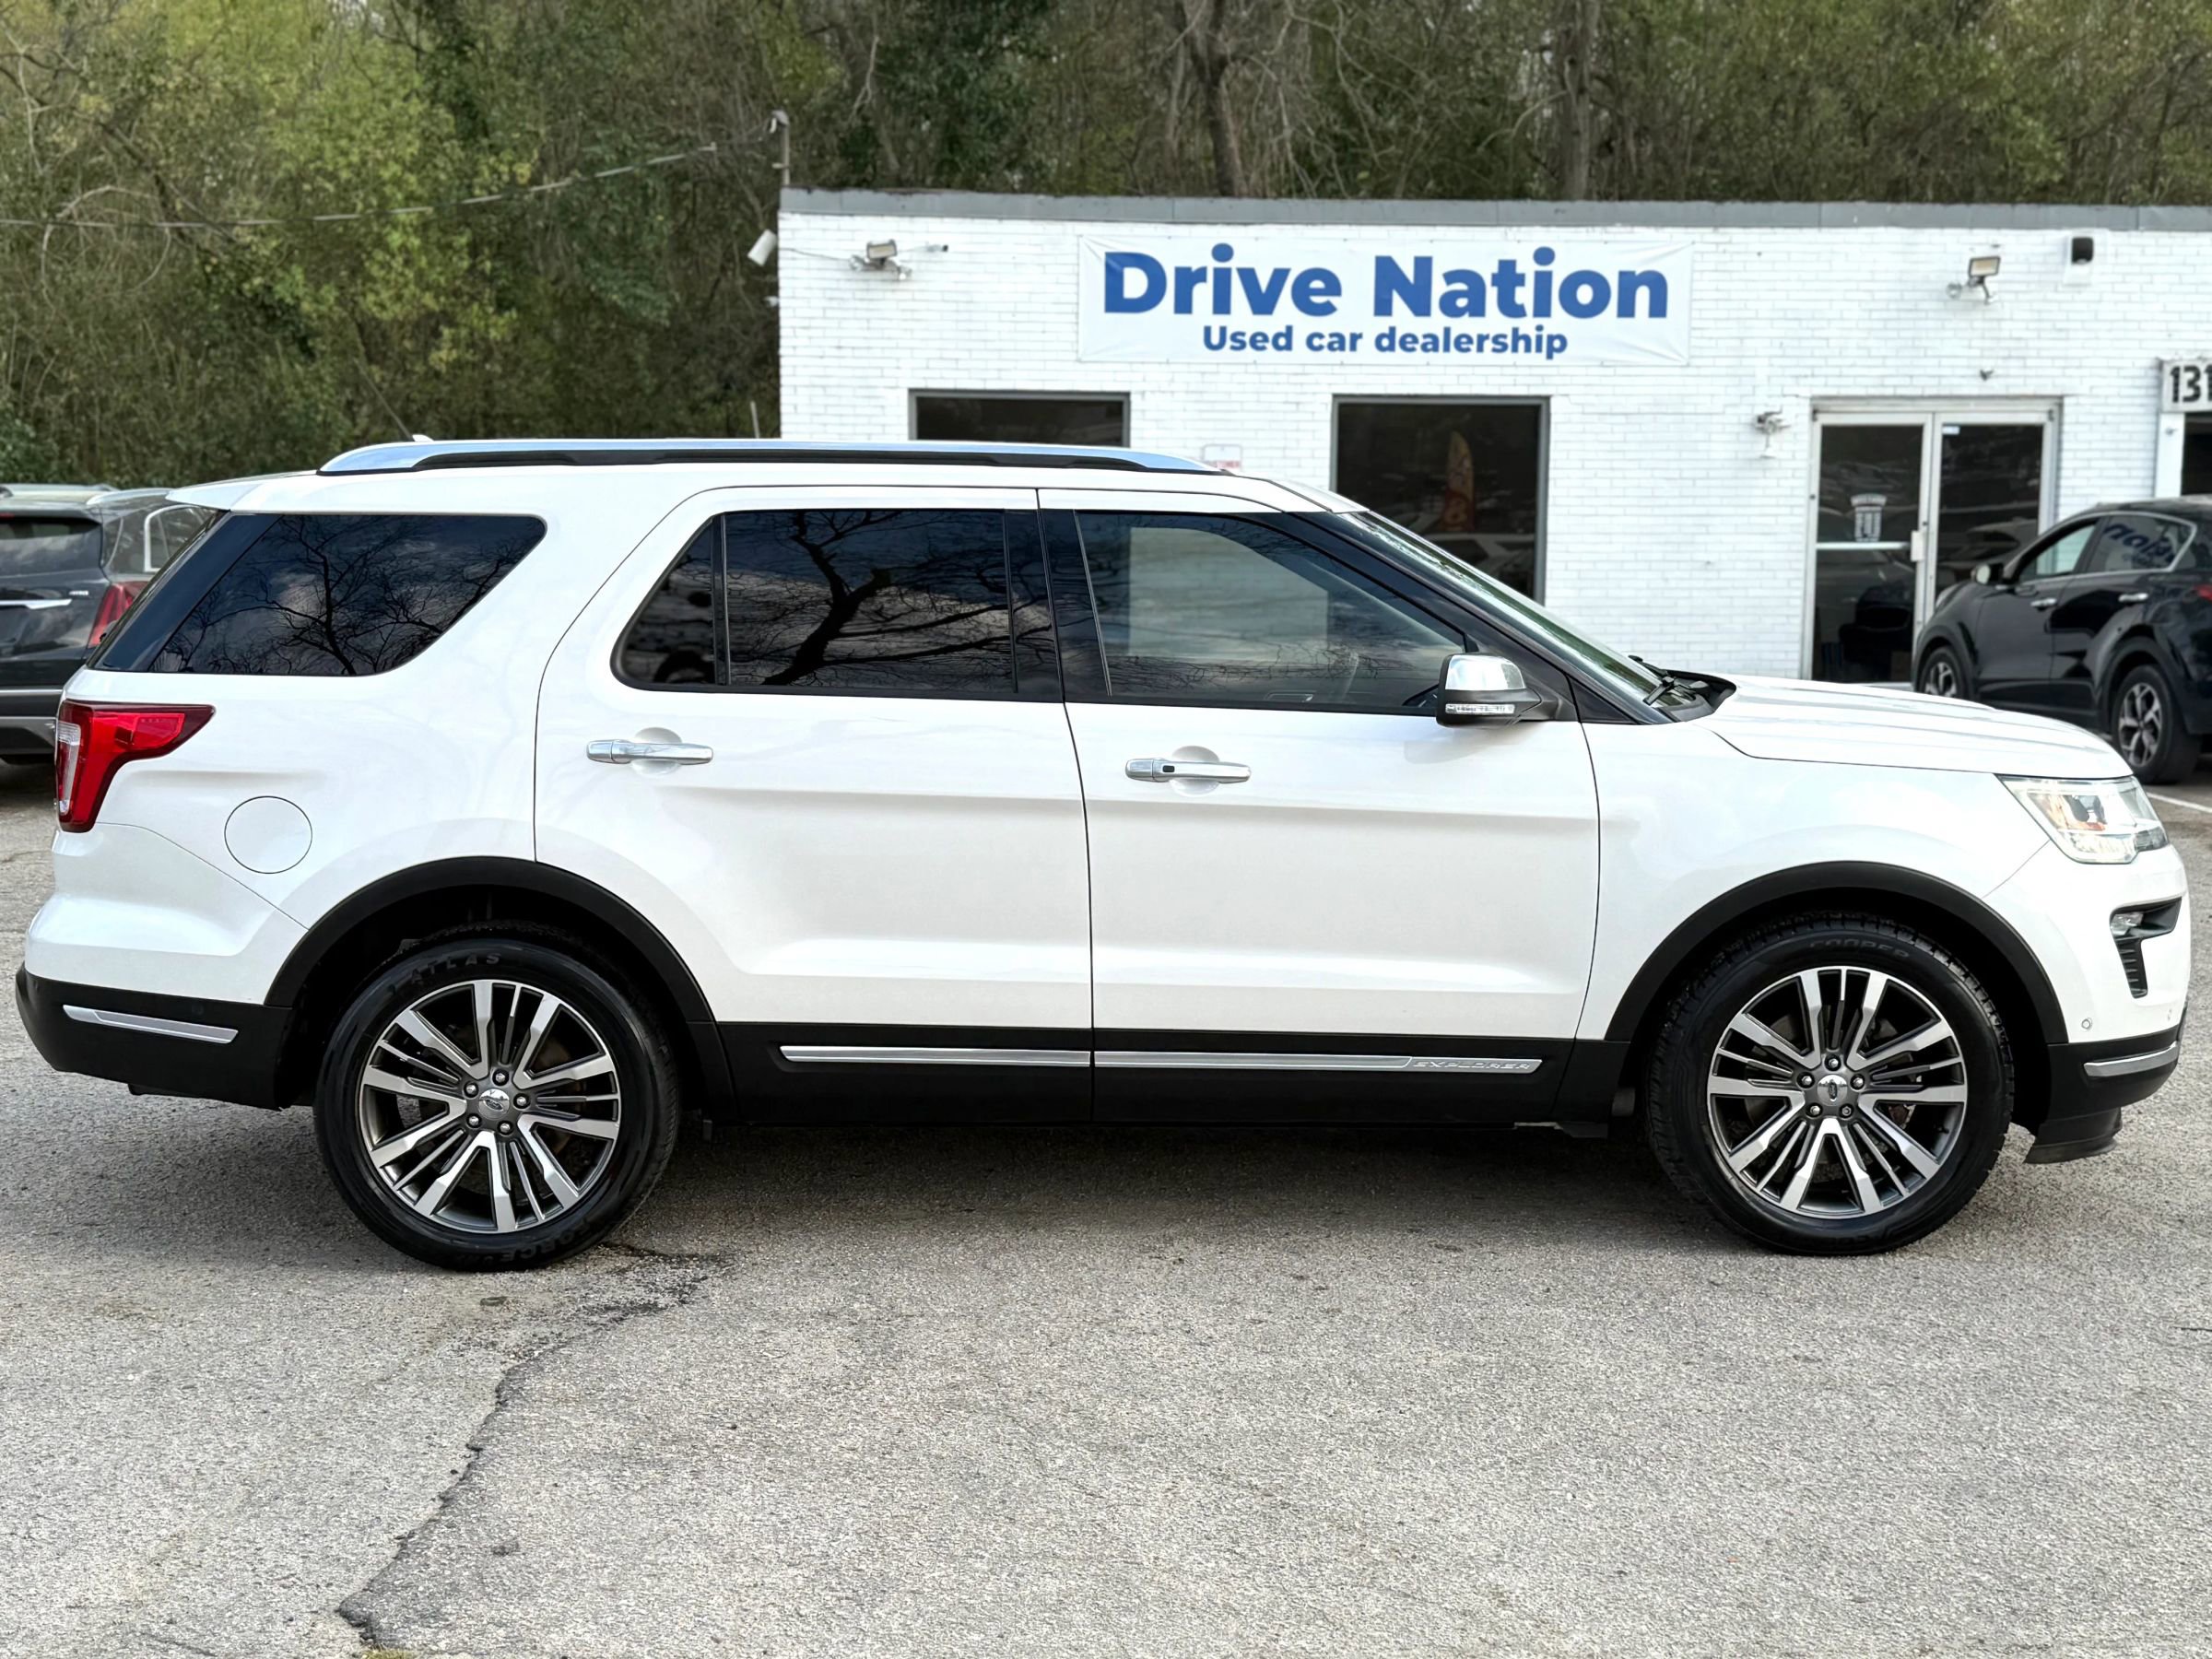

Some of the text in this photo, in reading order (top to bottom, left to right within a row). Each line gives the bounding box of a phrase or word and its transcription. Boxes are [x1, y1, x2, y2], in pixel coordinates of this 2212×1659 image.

[1103, 243, 1668, 319] Drive Nation
[1202, 324, 1568, 360] Used car dealership
[2170, 364, 2212, 403] 131
[410, 952, 502, 984] ATLAS
[1412, 1060, 1531, 1070] EXPLORER
